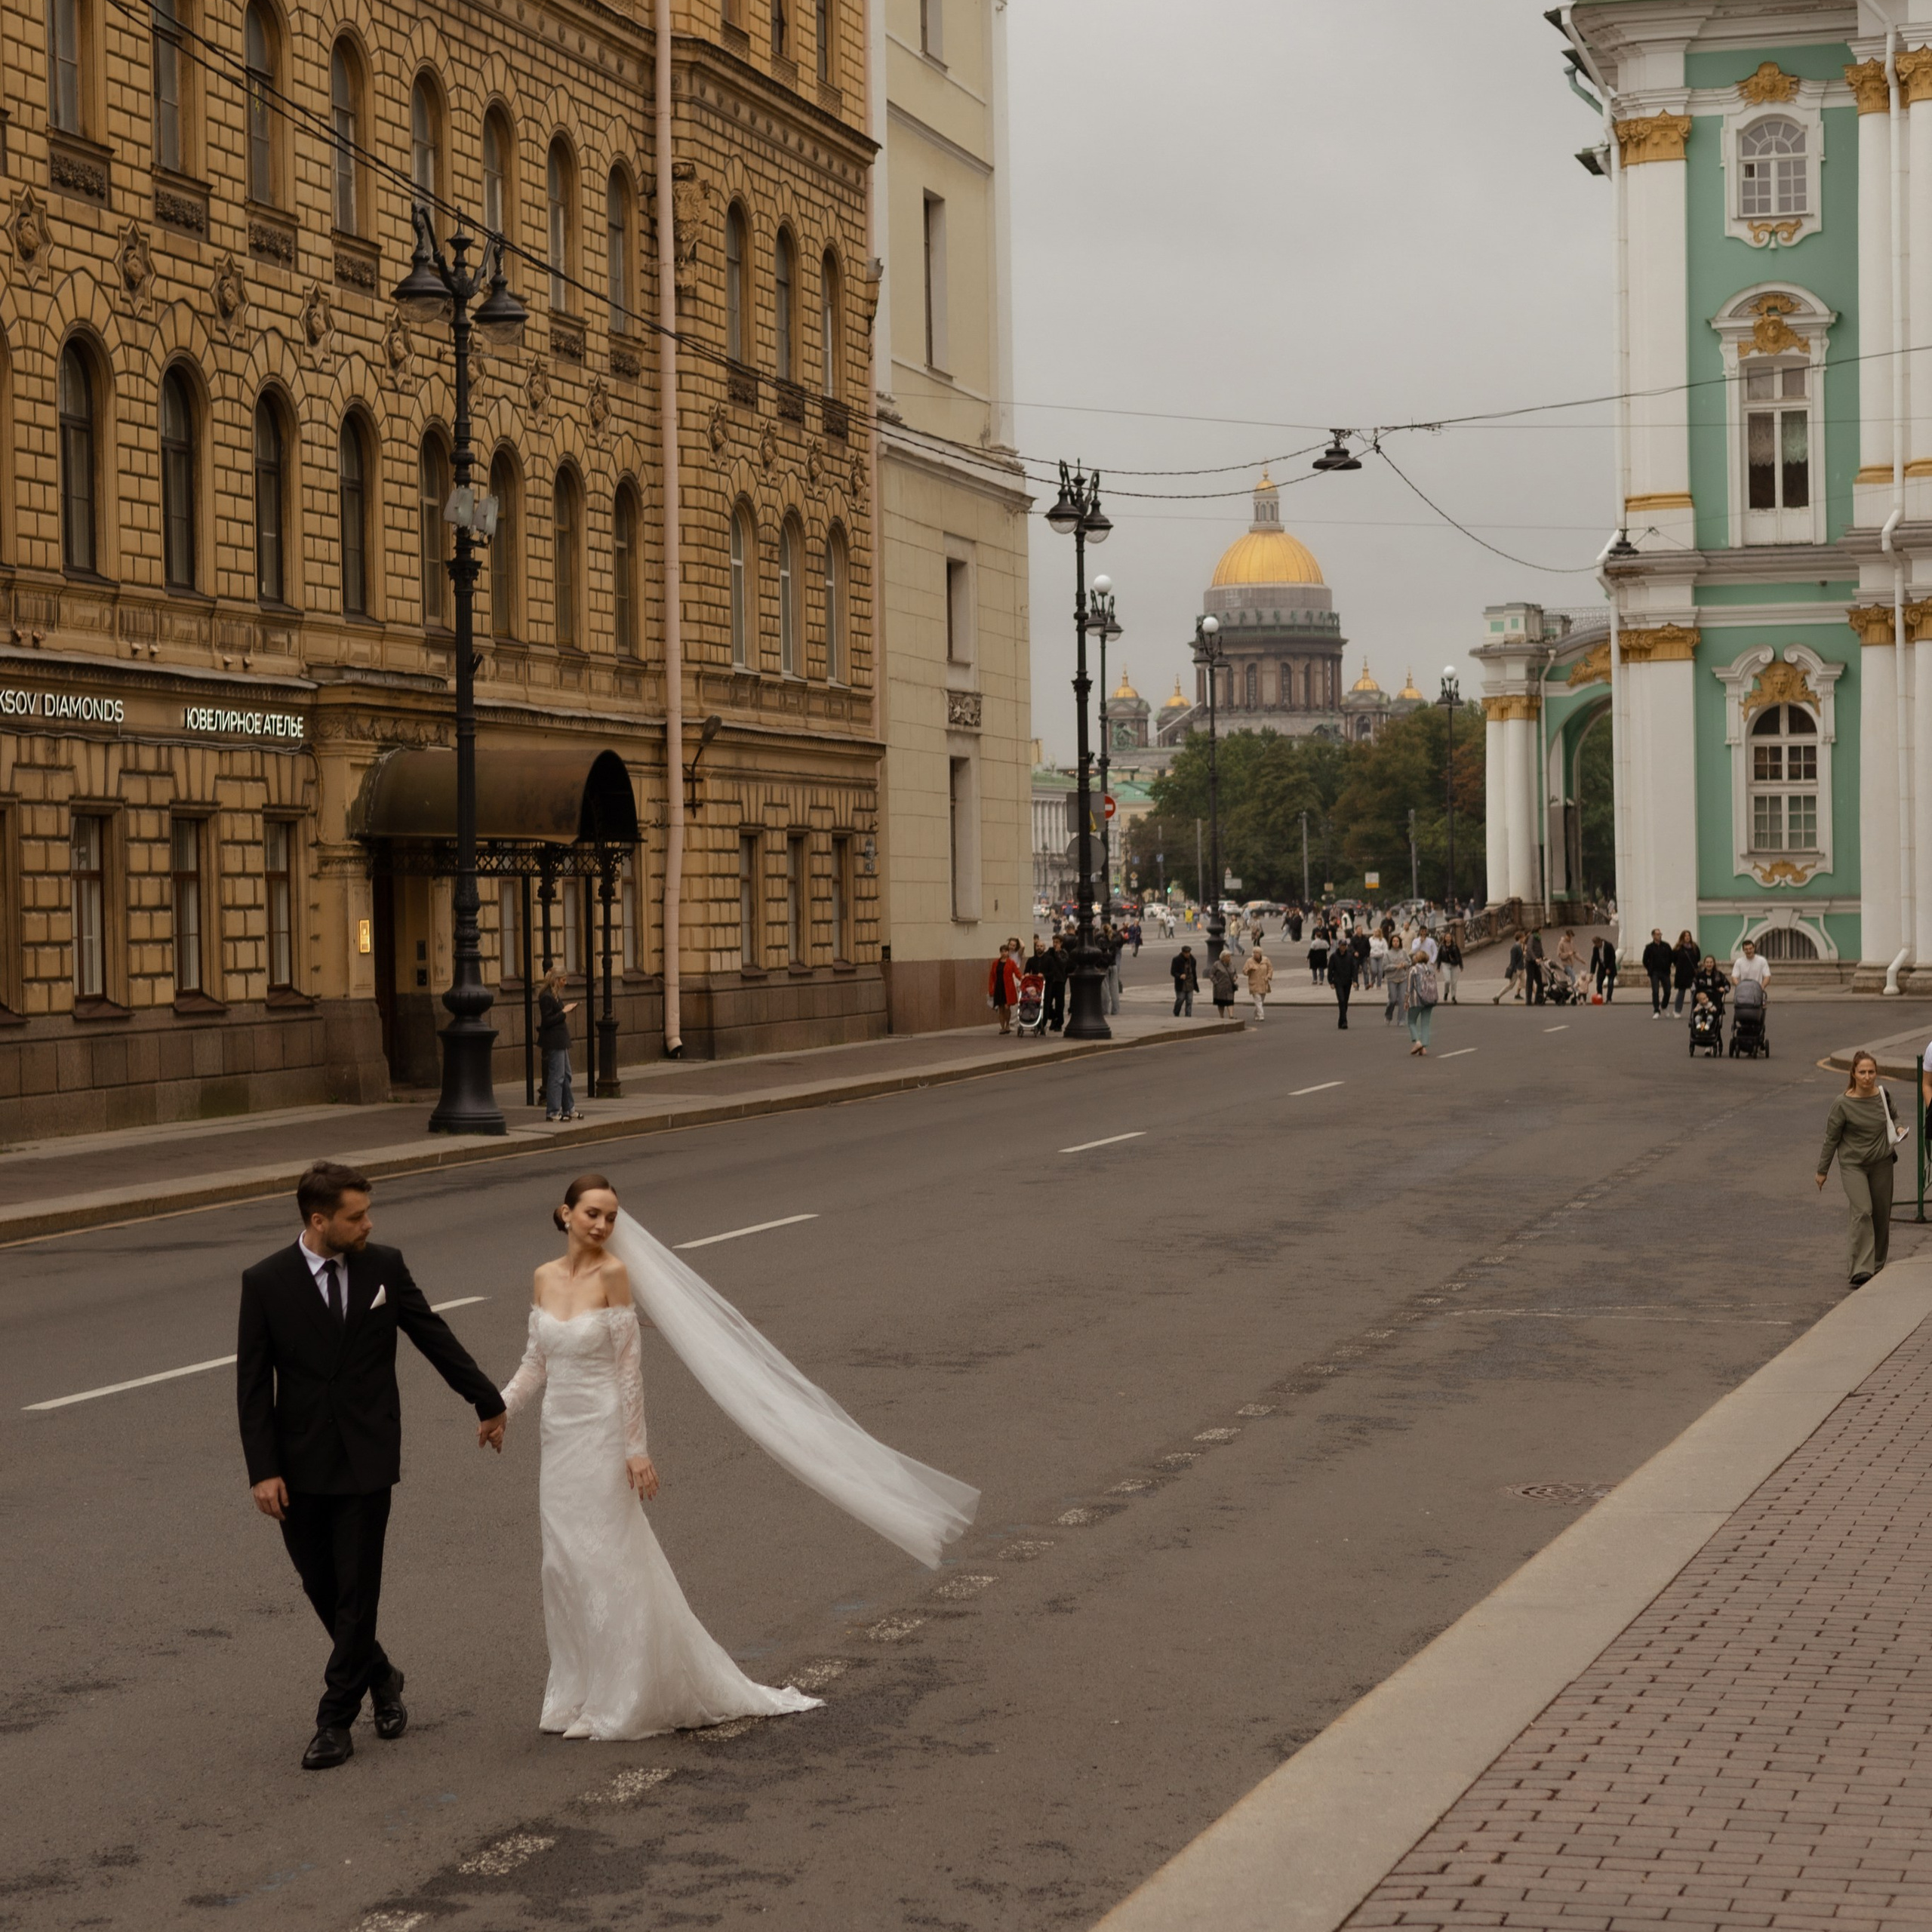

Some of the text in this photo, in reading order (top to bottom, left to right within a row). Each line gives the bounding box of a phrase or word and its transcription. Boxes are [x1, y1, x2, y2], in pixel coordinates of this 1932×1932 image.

[45, 693, 125, 723] DIAMONDS
[186, 706, 304, 738] ЮВЕЛИРНОЕ АТЕЛЬЕ
